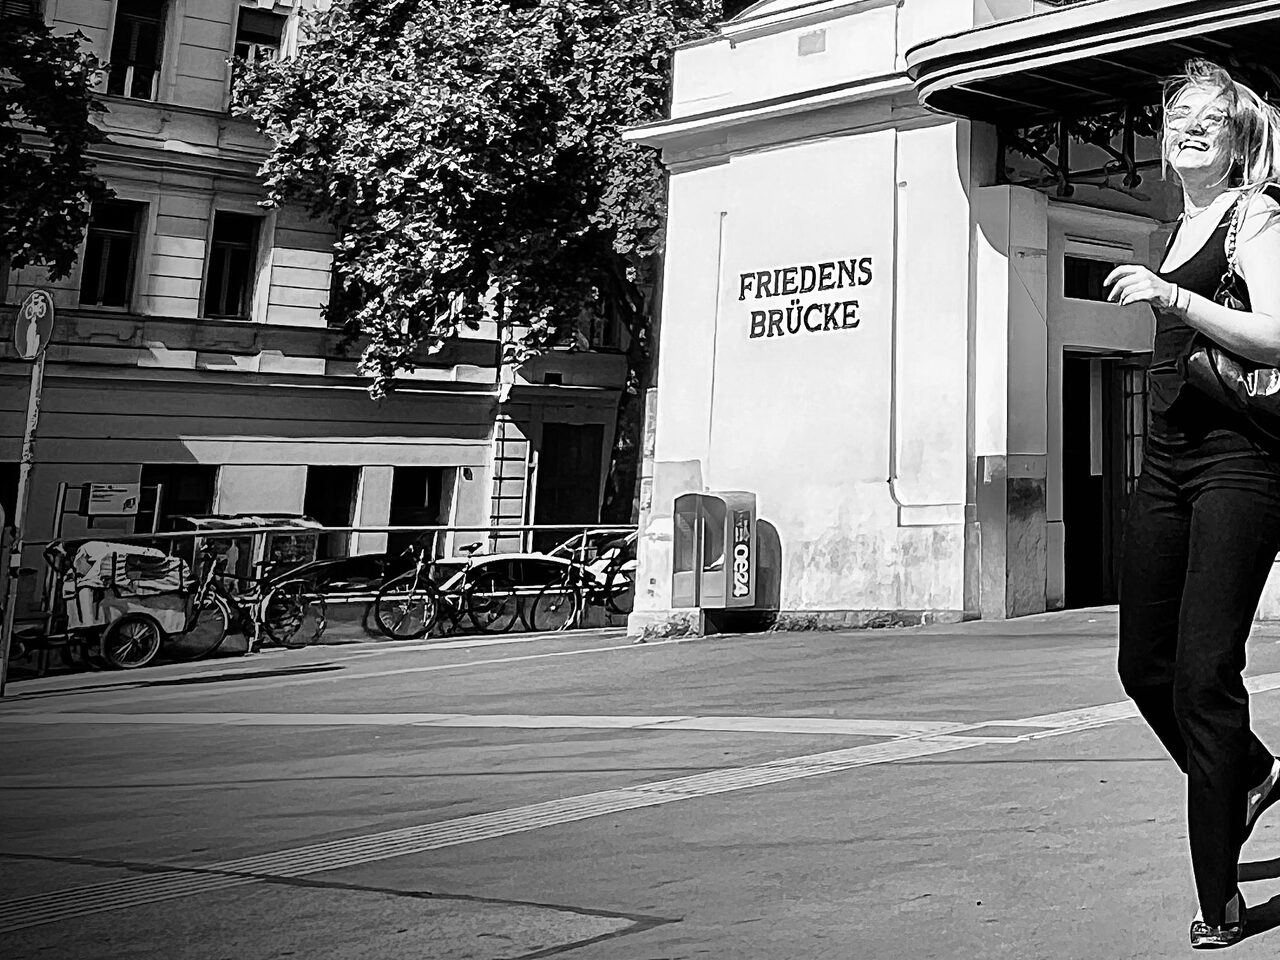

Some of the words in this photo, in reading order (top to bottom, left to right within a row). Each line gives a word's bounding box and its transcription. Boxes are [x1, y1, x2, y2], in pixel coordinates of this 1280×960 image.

[738, 257, 873, 301] FRIEDENS
[749, 298, 861, 339] BRÜCKE
[733, 544, 749, 597] oe24
